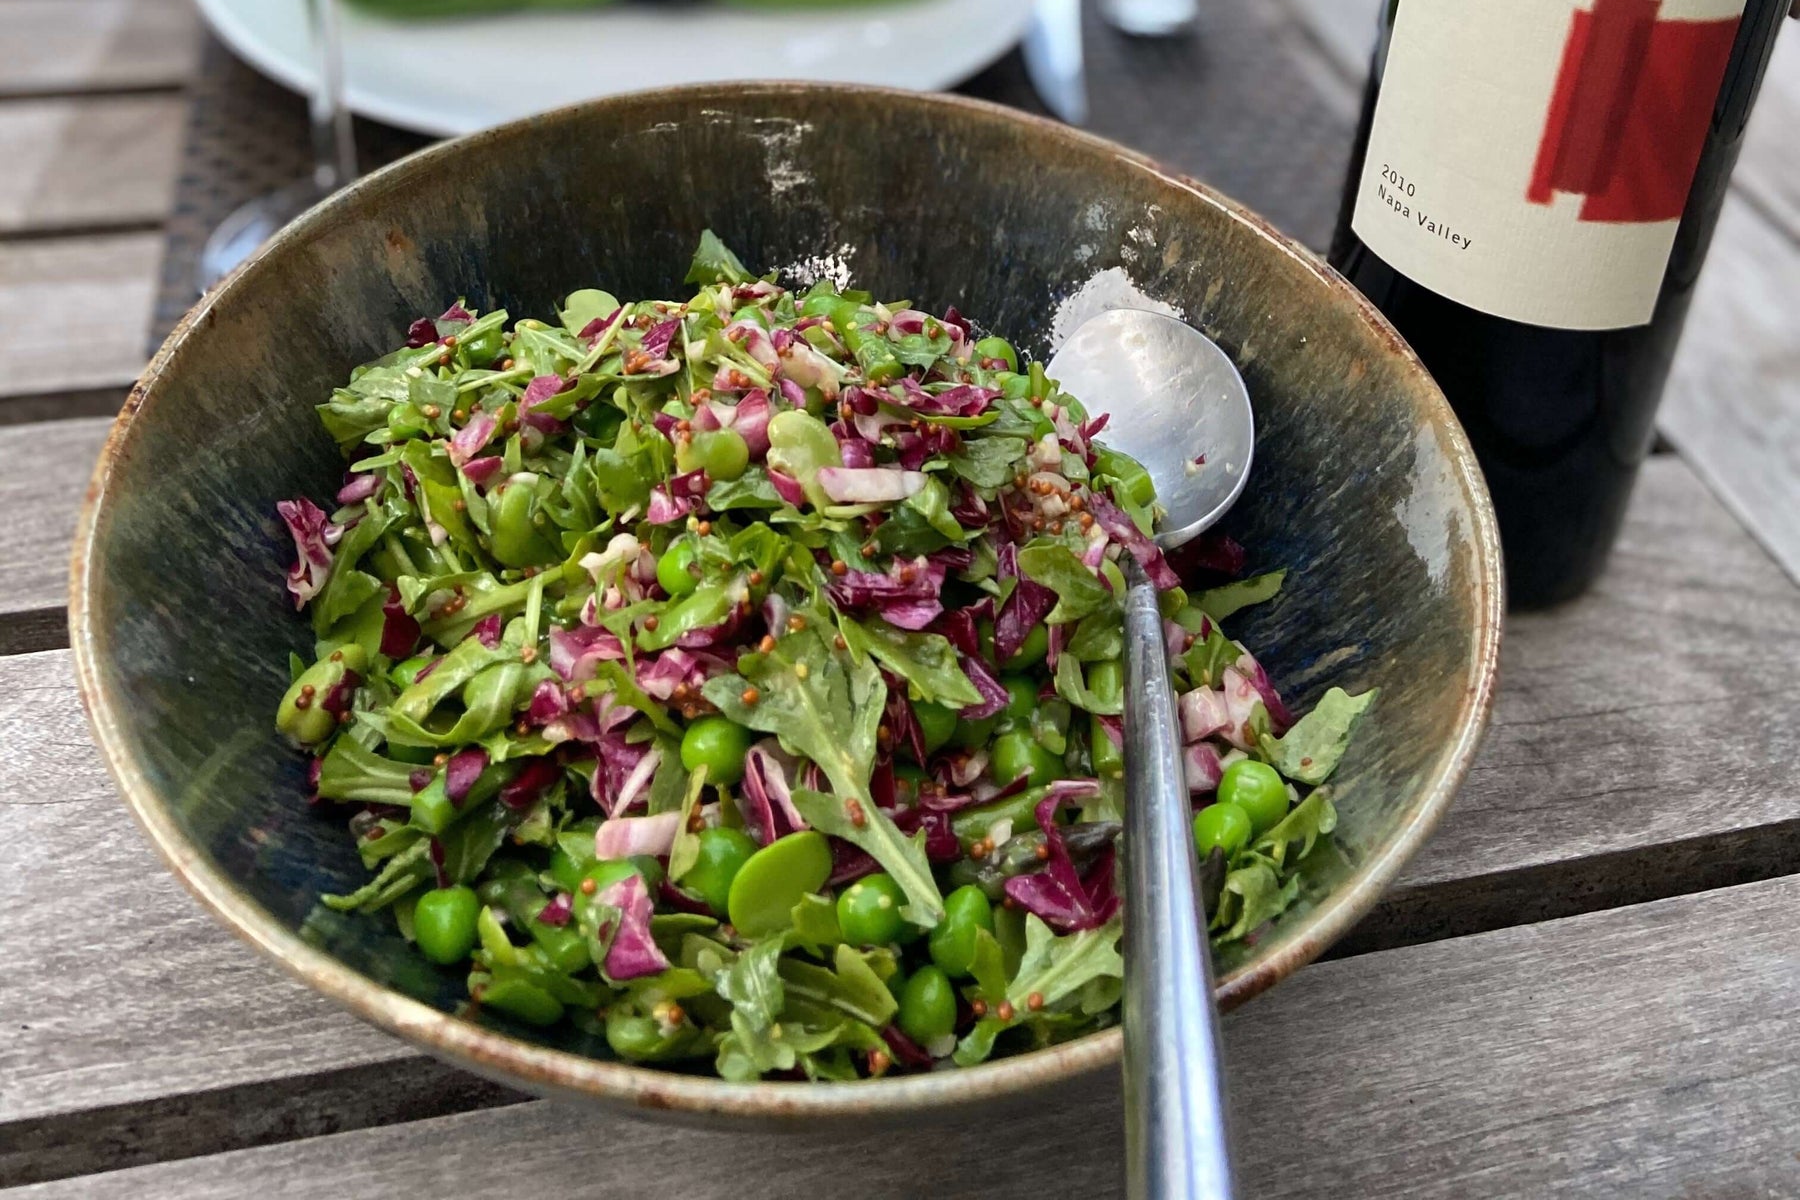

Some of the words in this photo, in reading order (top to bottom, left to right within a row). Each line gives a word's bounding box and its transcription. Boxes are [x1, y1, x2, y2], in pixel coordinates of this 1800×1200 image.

[1381, 163, 1415, 197] 2010
[1378, 184, 1410, 218] Napa
[1417, 211, 1472, 250] Valley
